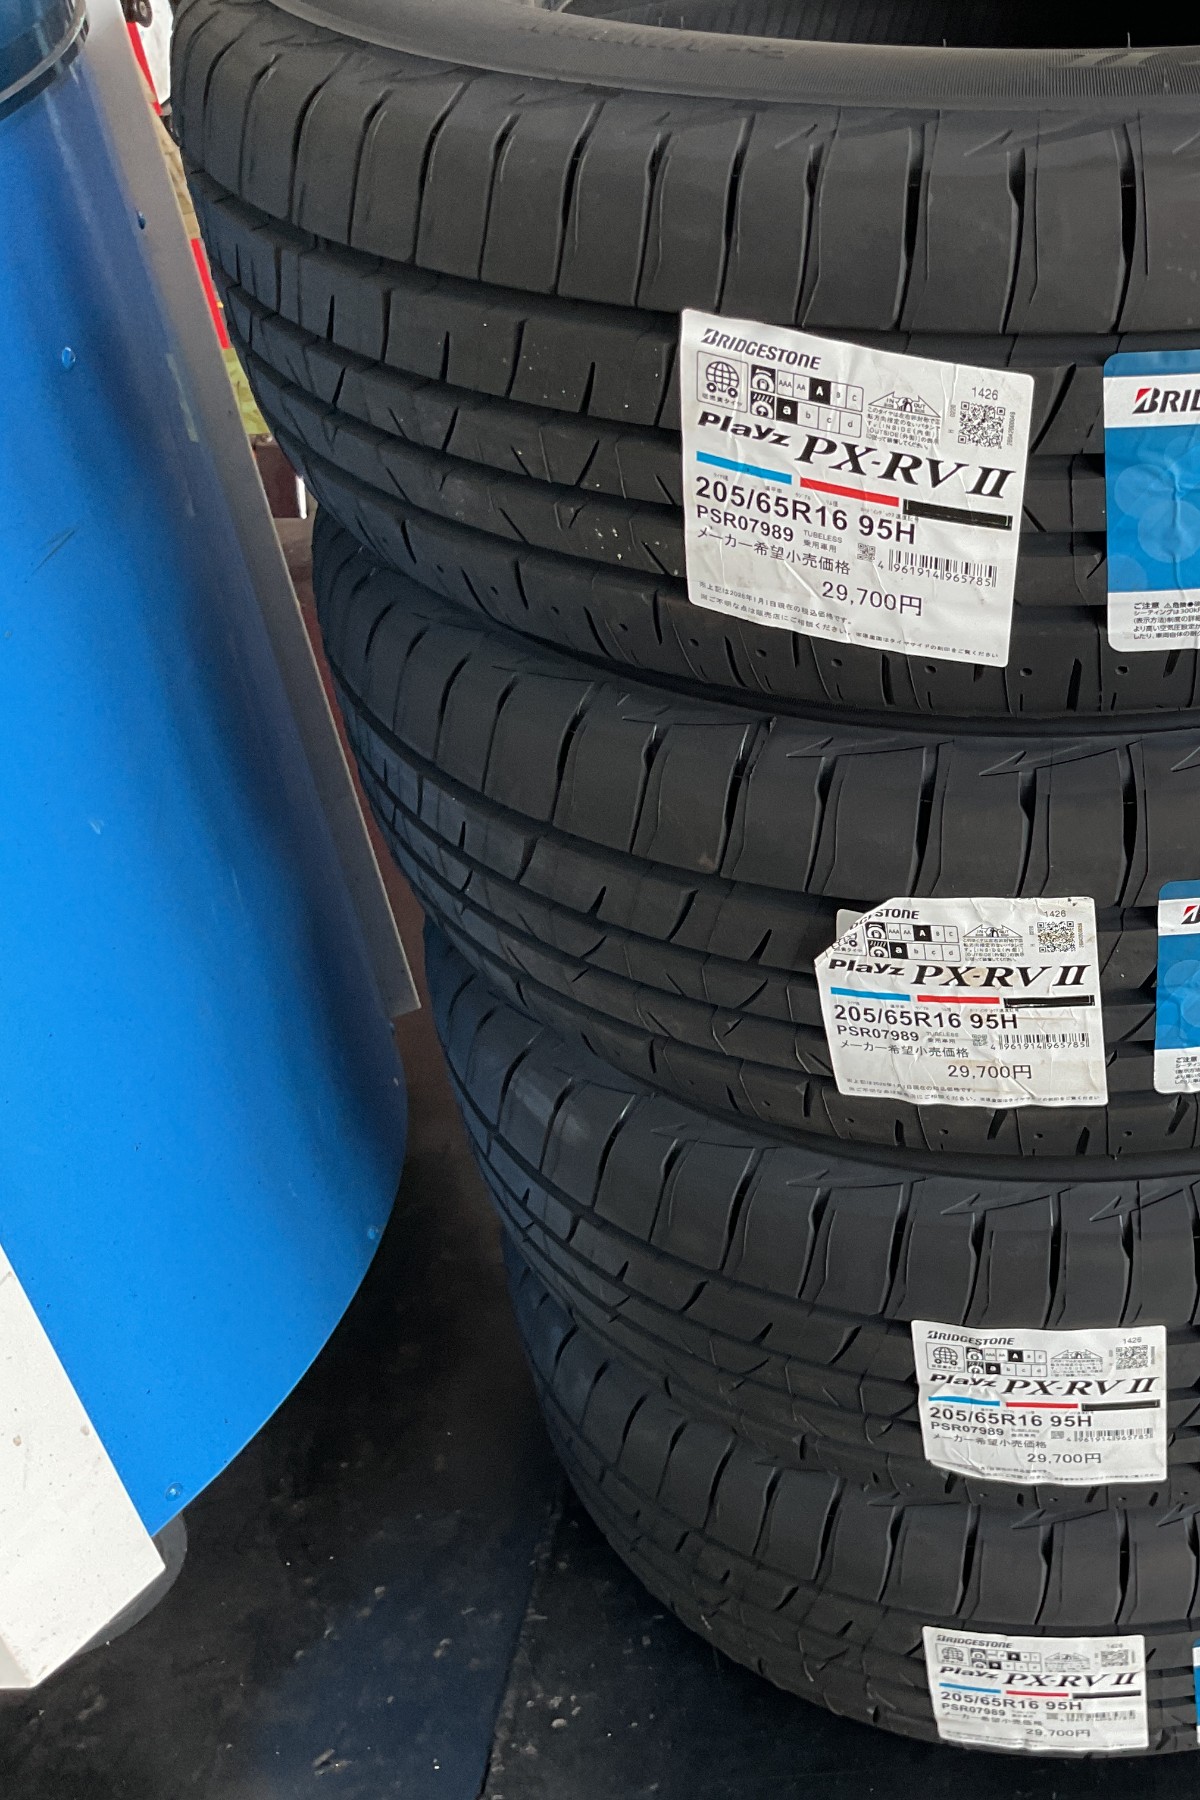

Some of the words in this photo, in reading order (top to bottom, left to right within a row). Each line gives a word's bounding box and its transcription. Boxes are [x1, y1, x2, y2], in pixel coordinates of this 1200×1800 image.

[700, 327, 822, 371] BRIDGESTONE
[778, 379, 793, 389] AAA
[796, 382, 806, 391] AA
[815, 386, 824, 397] A
[971, 386, 999, 401] 1426
[782, 404, 792, 416] a
[697, 410, 792, 447] Playz
[795, 433, 969, 490] PX-RV
[695, 475, 849, 532] 205/65R16
[858, 514, 916, 545] 95H
[695, 504, 795, 542] PSR07989
[803, 529, 843, 545] TUBELESS
[696, 524, 851, 576] メーカー希望小売価格
[893, 563, 939, 580] 961914
[945, 572, 991, 587] 965785
[821, 580, 923, 617] 29,700円
[1133, 601, 1160, 610] ご注意
[1043, 909, 1067, 918] 1426
[828, 958, 905, 977] Playz
[910, 964, 1053, 988] PX-RV
[833, 1003, 962, 1029] 205/65R16
[970, 1012, 1019, 1030] 95H
[836, 1024, 920, 1043] PSR07989
[840, 1040, 970, 1059] メーカー希望小売価格
[1003, 1041, 1042, 1051] 961914
[1046, 1040, 1086, 1050] 965785
[947, 1063, 1033, 1080] 29,700円
[926, 1330, 1016, 1346] BRIDGESTONE
[930, 1373, 998, 1387] Playz
[1001, 1378, 1127, 1396] PX-RV
[929, 1406, 1043, 1427] 205/65R16
[1050, 1414, 1093, 1428] 95H
[930, 1421, 1005, 1436] PSR07989
[932, 1433, 1047, 1449] メーカー希望小売価格
[1027, 1452, 1102, 1465] 29,700円
[936, 1634, 1014, 1648] BRIDGESTONE
[939, 1666, 1000, 1679] Playz
[1001, 1673, 1111, 1687] PX-RV
[940, 1691, 1039, 1710] 205/65R16
[1045, 1701, 1082, 1711] 95H
[941, 1702, 1006, 1716] PSR07989
[1025, 1728, 1091, 1738] 29,700円
